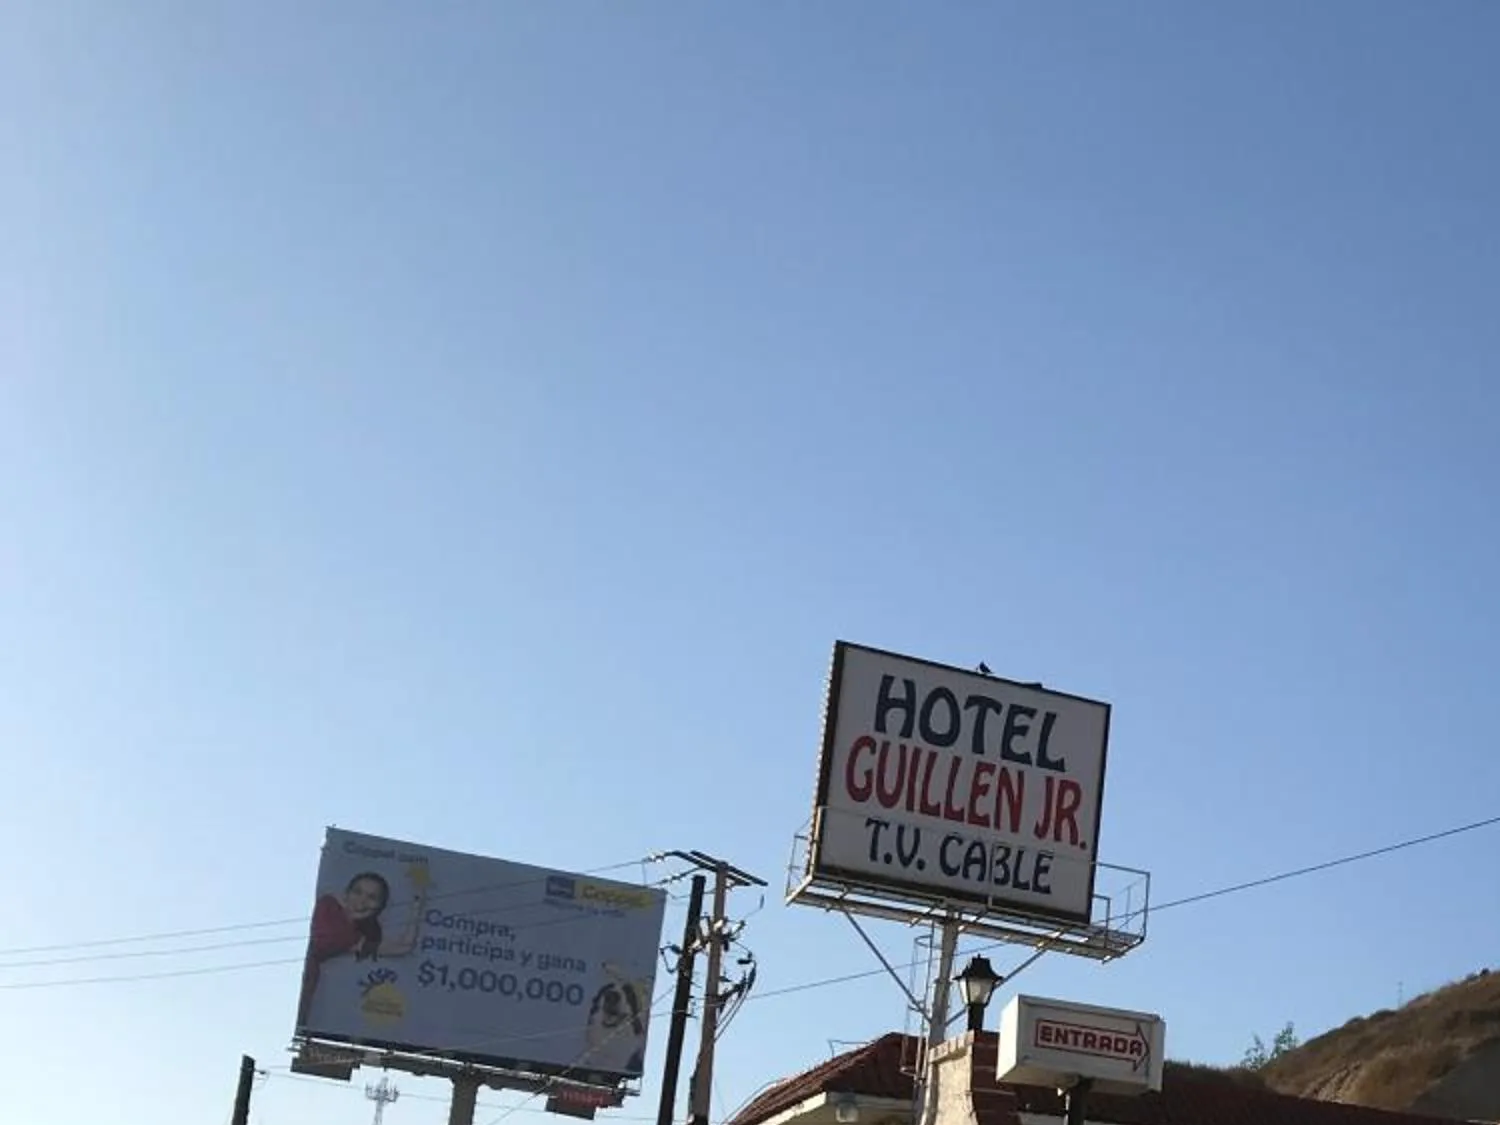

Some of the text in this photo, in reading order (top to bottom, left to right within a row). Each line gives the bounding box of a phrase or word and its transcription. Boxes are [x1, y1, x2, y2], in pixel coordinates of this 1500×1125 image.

[874, 674, 1067, 773] HOTEL
[845, 735, 1088, 850] GUILLEN JR.
[865, 818, 1055, 895] T.V. CABLE
[425, 909, 517, 941] Compra,
[421, 936, 587, 974] participa y gana
[418, 960, 585, 1006] $1,000,000
[1040, 1025, 1143, 1057] ENTRADA
